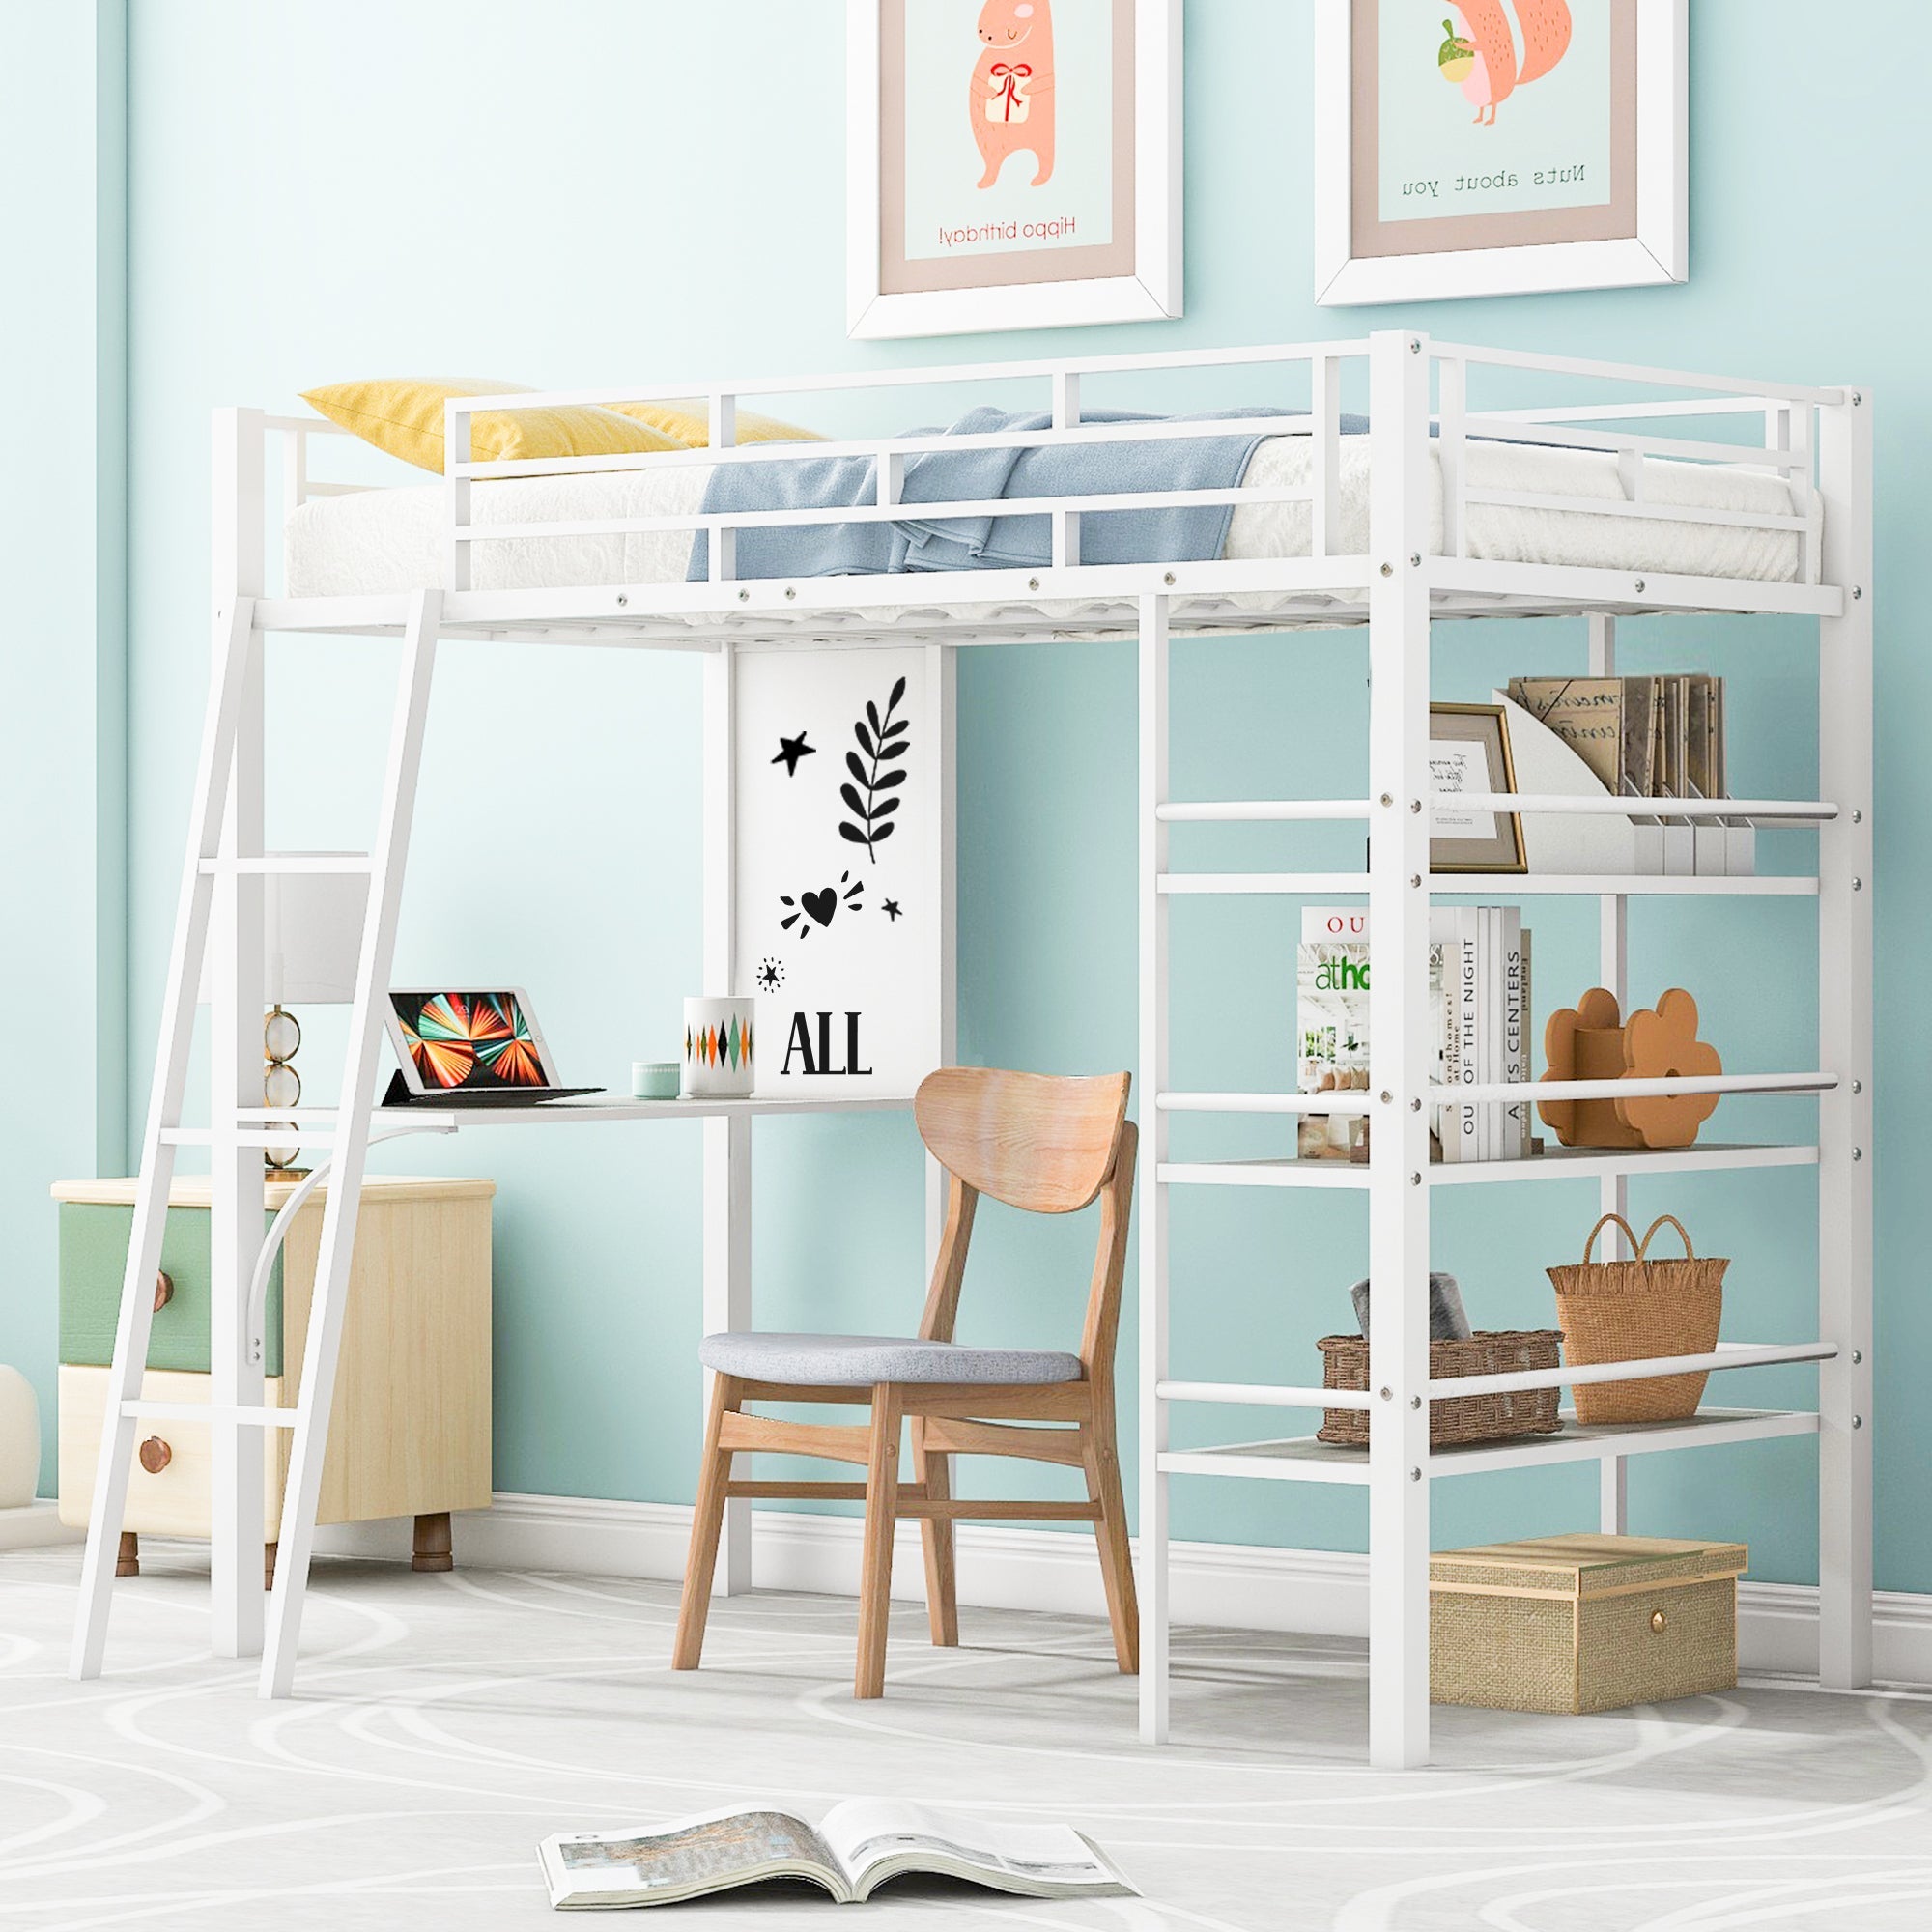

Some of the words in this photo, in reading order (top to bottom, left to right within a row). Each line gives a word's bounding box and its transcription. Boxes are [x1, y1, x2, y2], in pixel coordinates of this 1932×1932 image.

[1463, 938, 1475, 1002] NIGHT
[1463, 1011, 1475, 1049] THE
[1507, 952, 1520, 1053] CENTERS
[780, 1011, 873, 1075] ALL
[1463, 1059, 1475, 1084] OF
[1507, 1064, 1520, 1120] ATS
